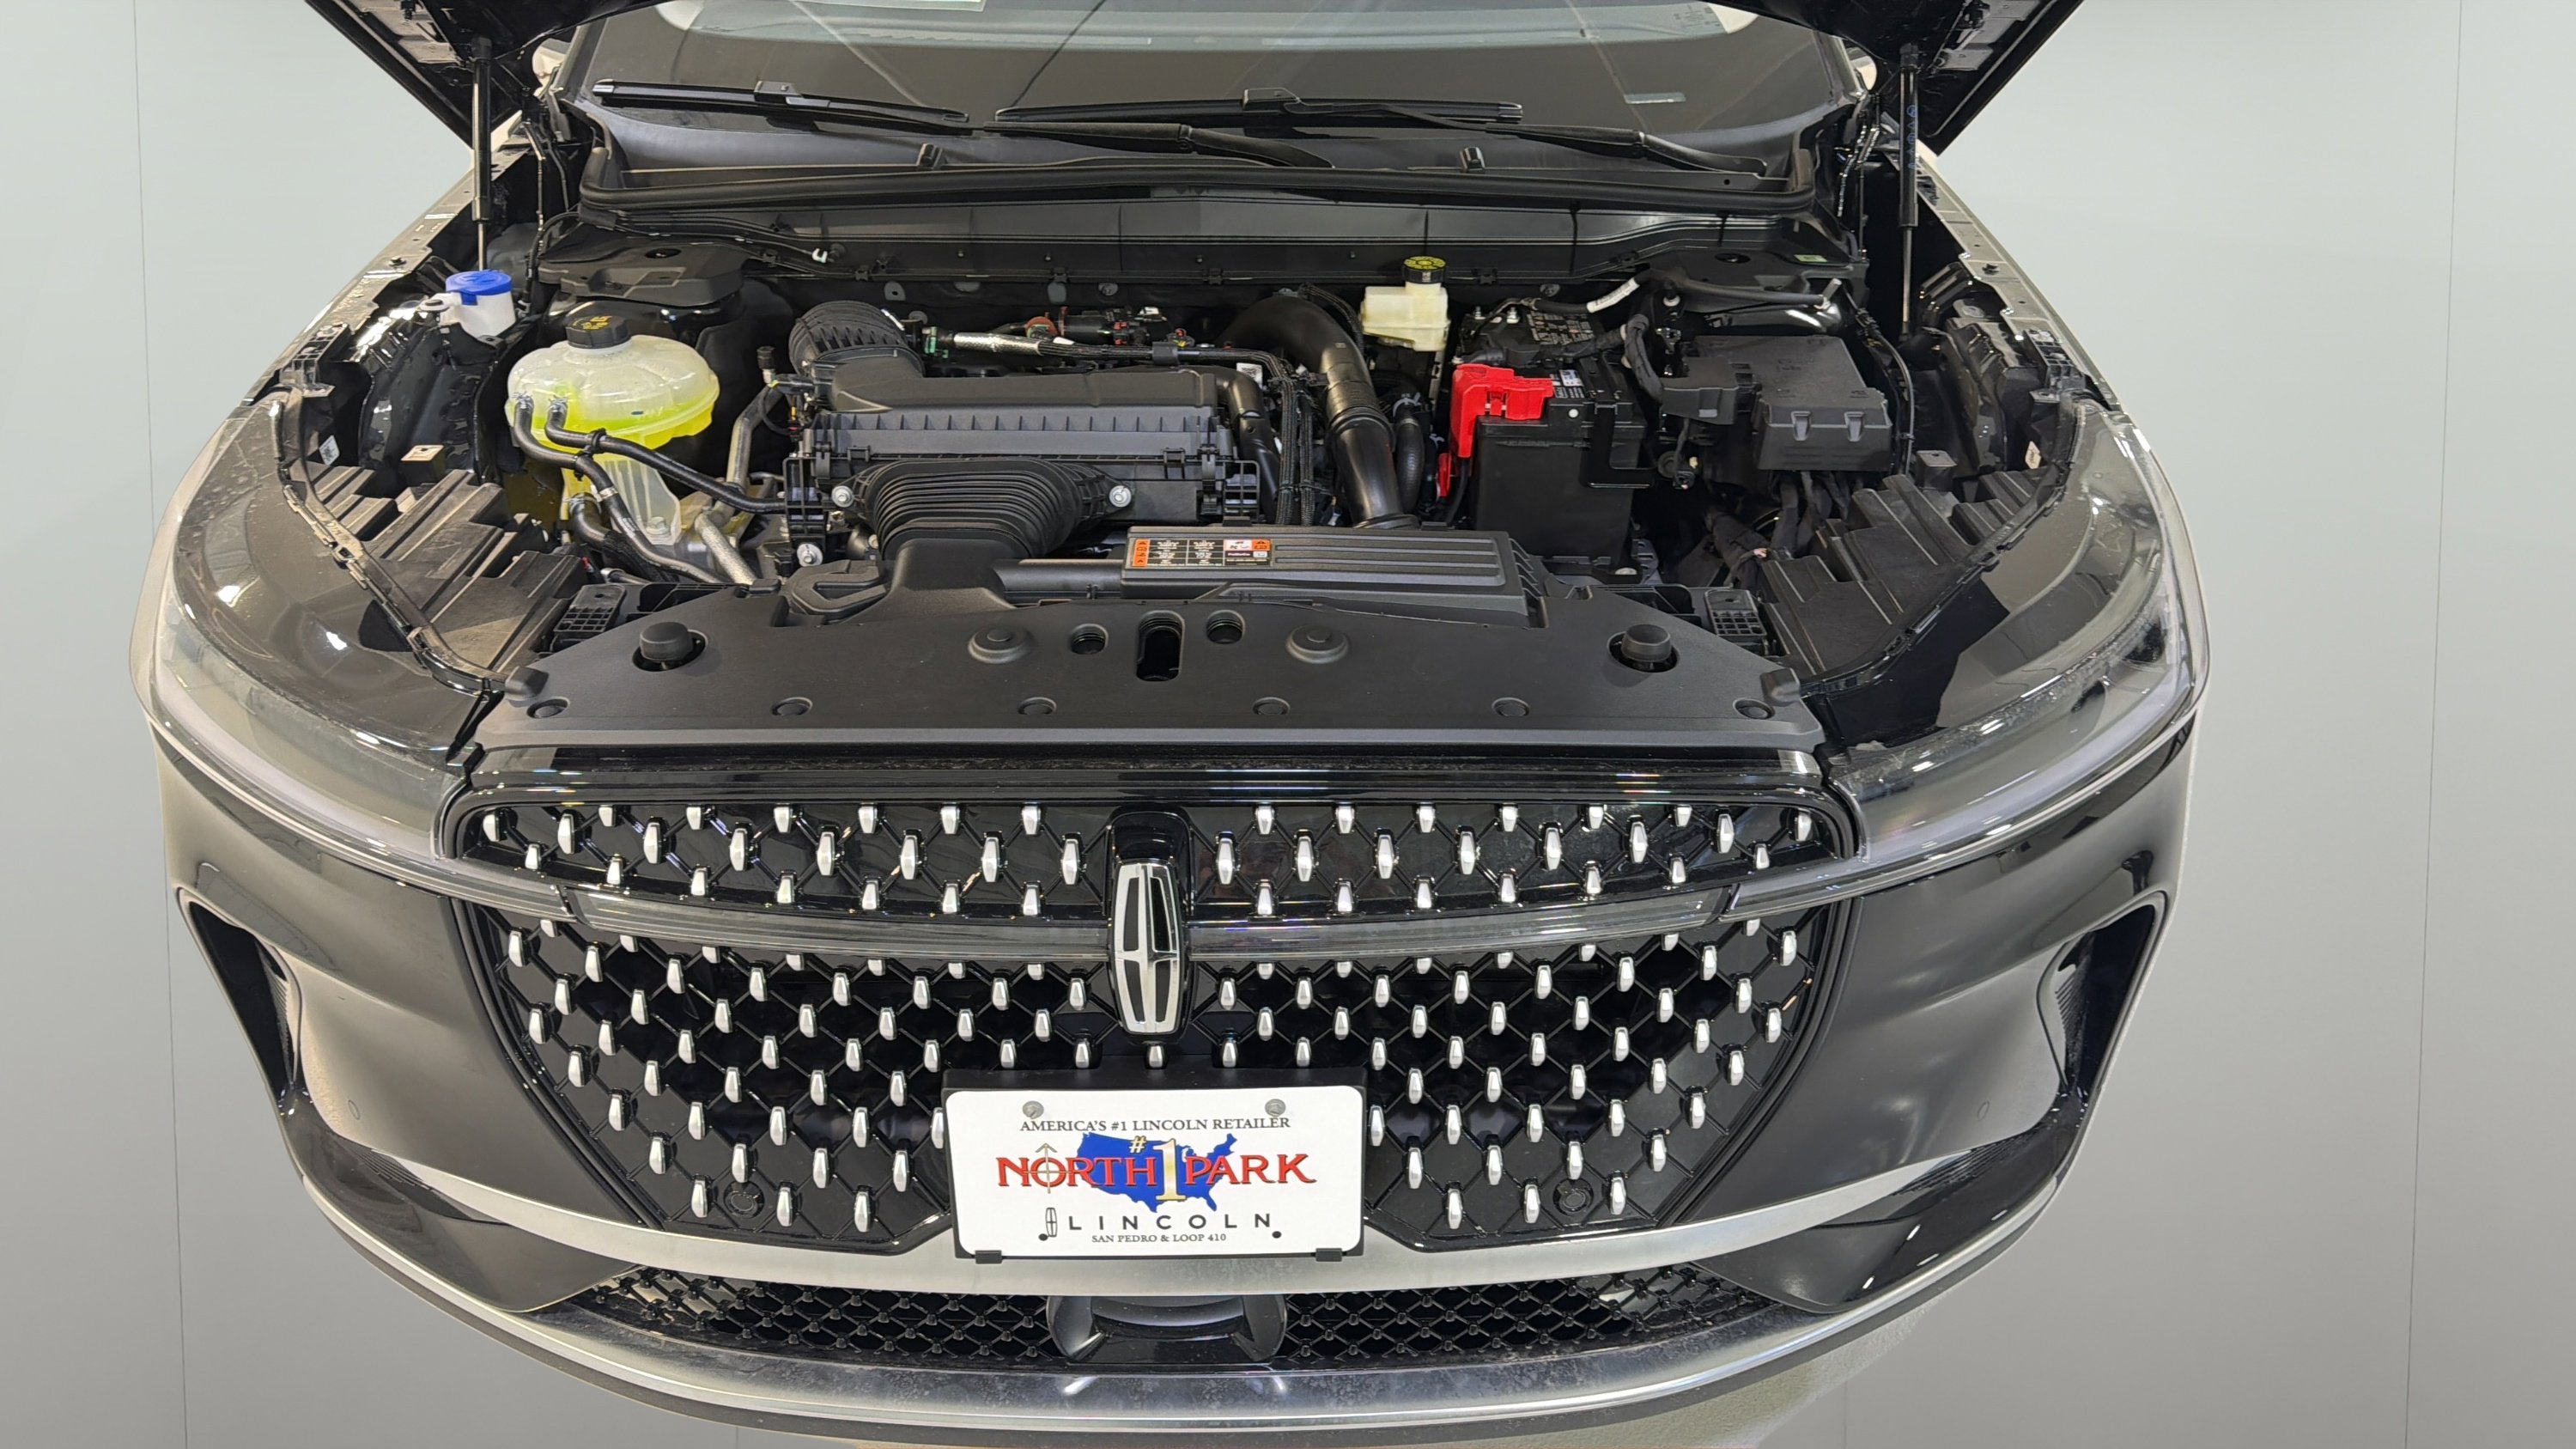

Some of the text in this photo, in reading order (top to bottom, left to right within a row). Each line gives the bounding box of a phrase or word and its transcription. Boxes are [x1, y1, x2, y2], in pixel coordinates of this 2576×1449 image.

[1020, 1117, 1291, 1131] AMERICA'S #1 LINCOLN RETAILER
[996, 1153, 1316, 1187] NORTH PARK
[1068, 1213, 1271, 1231] LINCOLN
[1117, 1234, 1157, 1243] PEDRO
[1207, 1233, 1227, 1242] 410
